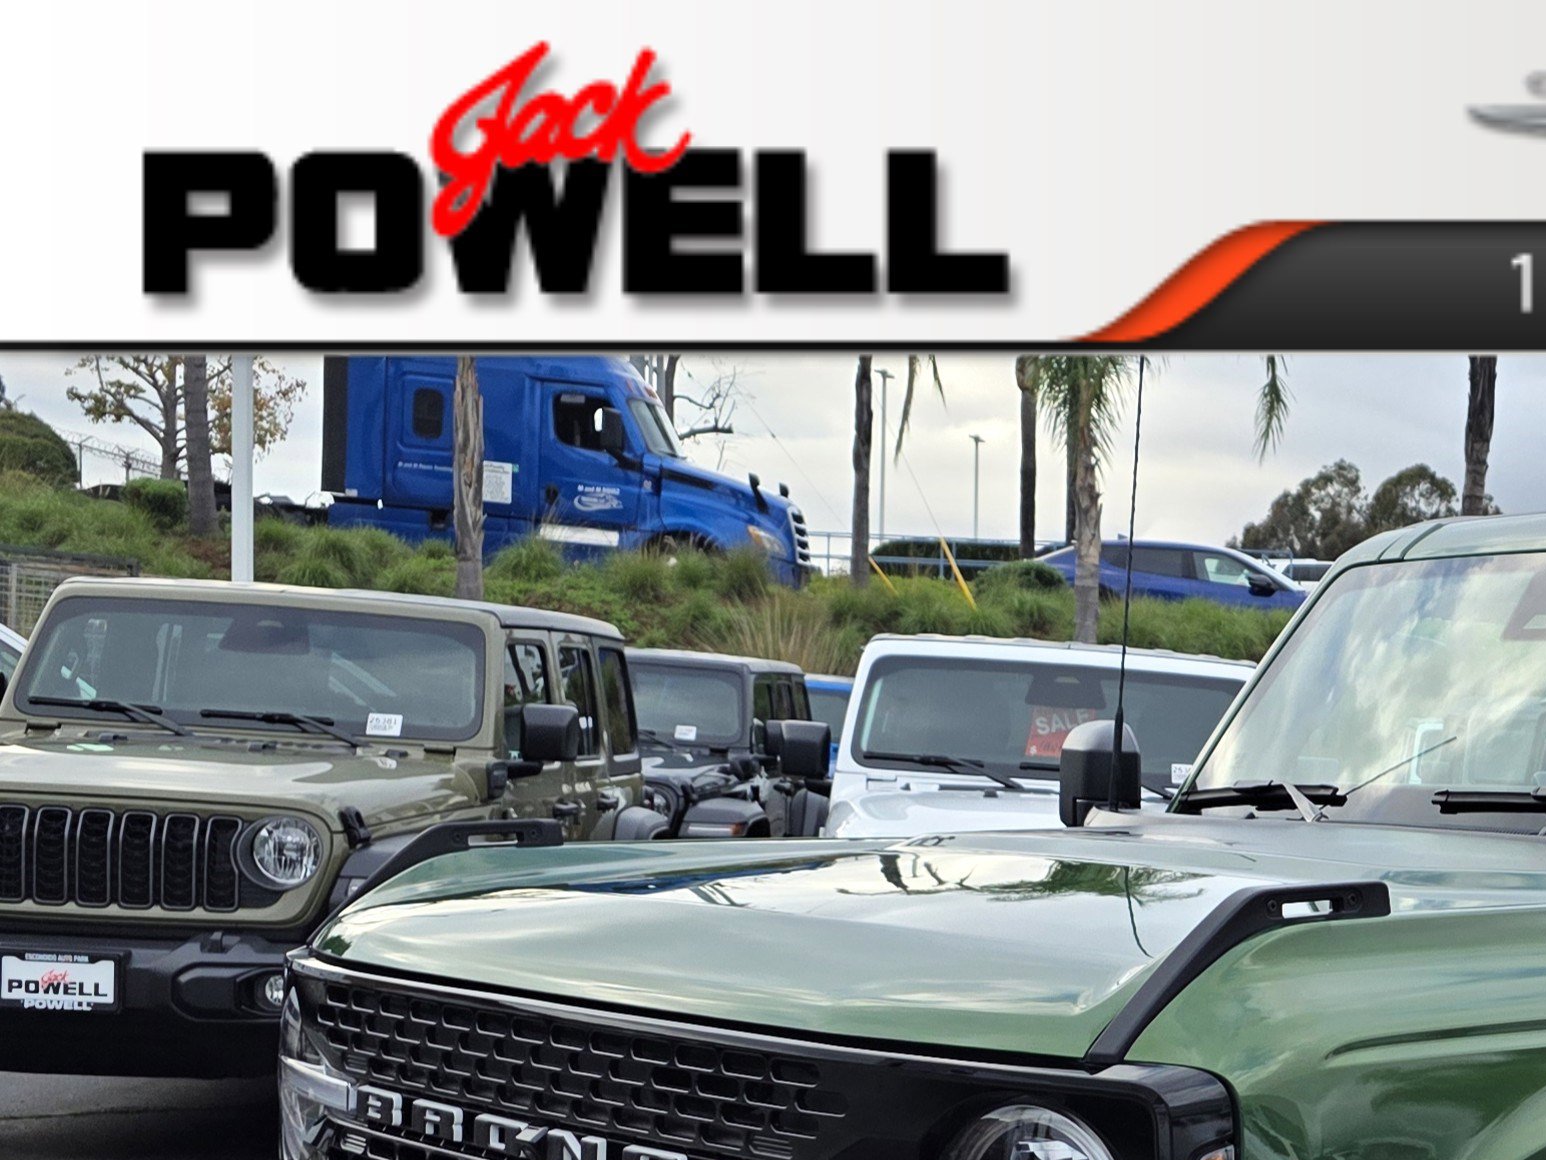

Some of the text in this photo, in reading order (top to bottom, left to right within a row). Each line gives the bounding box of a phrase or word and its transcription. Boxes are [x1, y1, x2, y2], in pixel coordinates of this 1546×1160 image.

[1035, 708, 1090, 735] SALE
[8, 978, 108, 997] POWELL
[24, 999, 92, 1011] POWELL
